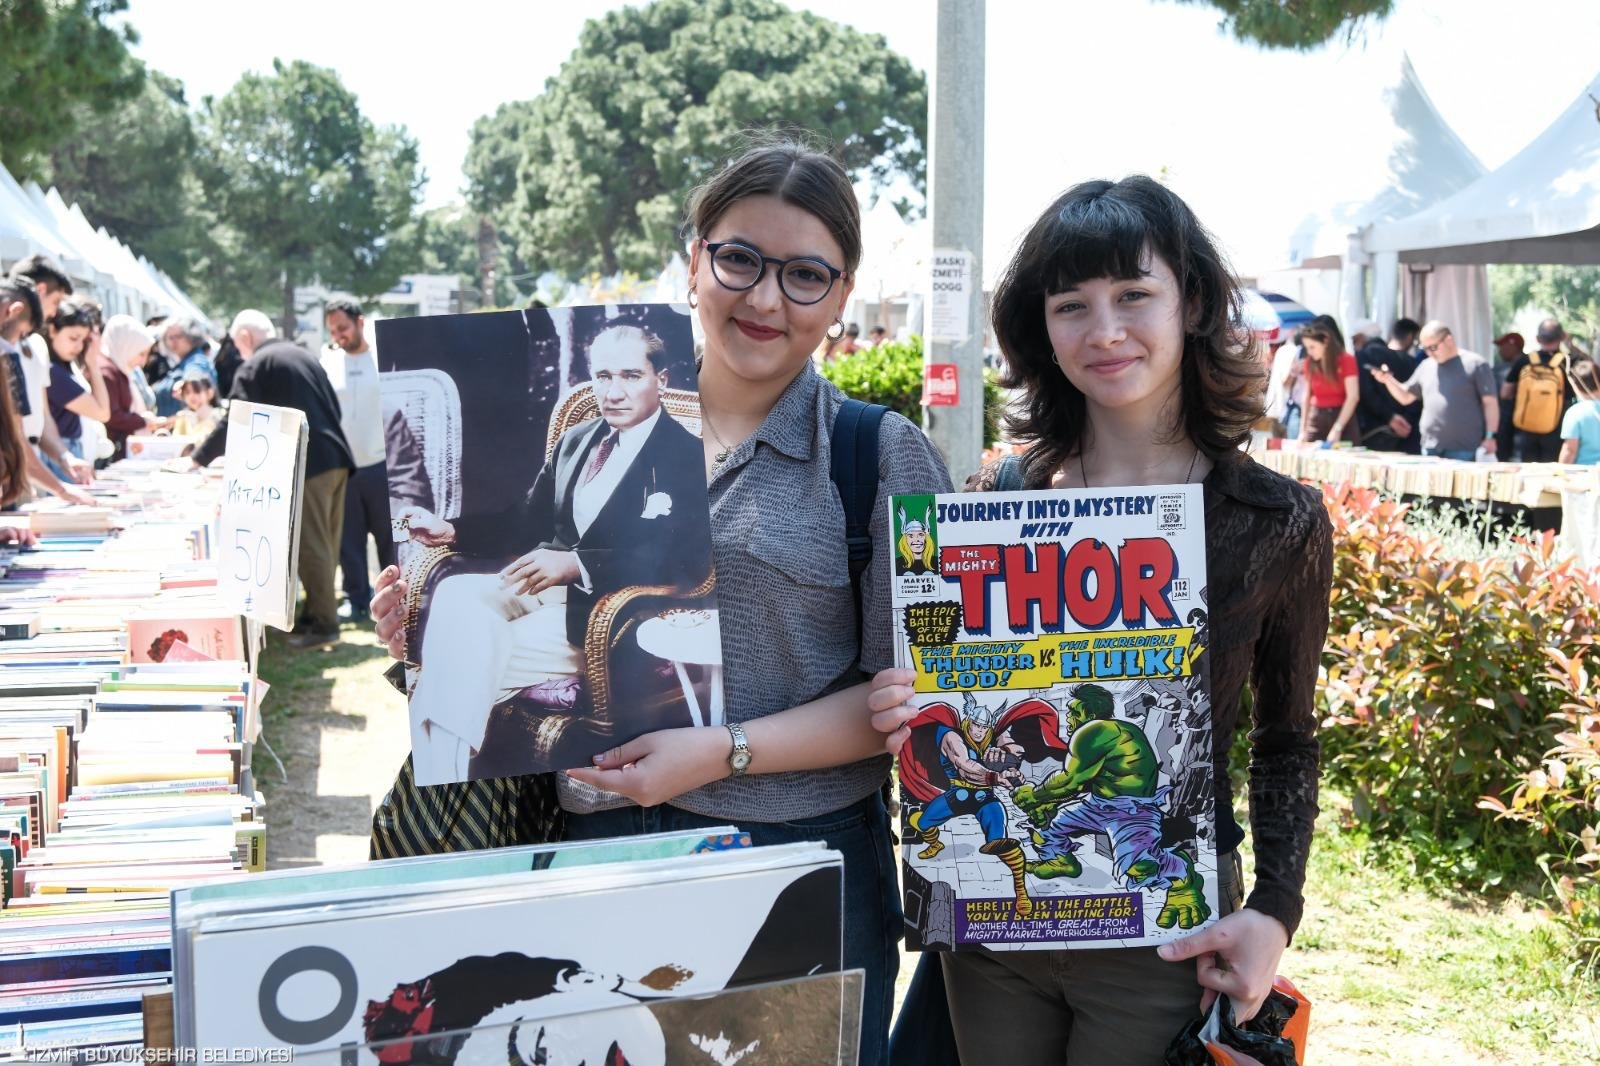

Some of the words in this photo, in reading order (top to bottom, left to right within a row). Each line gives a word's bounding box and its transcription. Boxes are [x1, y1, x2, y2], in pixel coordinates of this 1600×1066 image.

[245, 412, 270, 470] 5
[937, 501, 1023, 523] JOURNEY
[1027, 498, 1070, 520] INTO
[1074, 495, 1156, 517] MYSTERY
[1020, 522, 1073, 538] WITH
[235, 528, 272, 587] 50
[960, 550, 980, 558] THE
[945, 559, 997, 571] MIGHTY
[940, 537, 1181, 636] THOR
[1174, 581, 1187, 591] 112
[909, 608, 930, 616] THE
[933, 606, 957, 616] EPIC
[909, 616, 952, 627] BATTLE
[917, 633, 948, 643] AGE!
[1059, 639, 1089, 650] THE
[1092, 634, 1177, 649] INCREDIBLE
[920, 647, 954, 657] THE
[957, 643, 1024, 655] MIGHTY
[1039, 648, 1056, 667] VS.
[922, 654, 1036, 673] THUNDER
[1060, 646, 1186, 679] HULK!
[937, 671, 1012, 689] GOD!
[966, 901, 998, 911] HERE
[1002, 901, 1013, 910] IT
[1057, 899, 1081, 909] THE
[1084, 896, 1131, 908] BATTLE
[966, 911, 1009, 922] YOU'VE
[1054, 908, 1104, 919] WAITING
[1108, 906, 1138, 917] FOR!
[964, 930, 1004, 940] MIGHTY
[1045, 928, 1101, 938] POWERHOUSE
[1110, 924, 1139, 936] IDEAS!
[968, 921, 1008, 931] ANOTHER
[1010, 920, 1053, 930] ALL-TIME
[1058, 918, 1095, 929] GREAT
[1099, 918, 1128, 927] FROM
